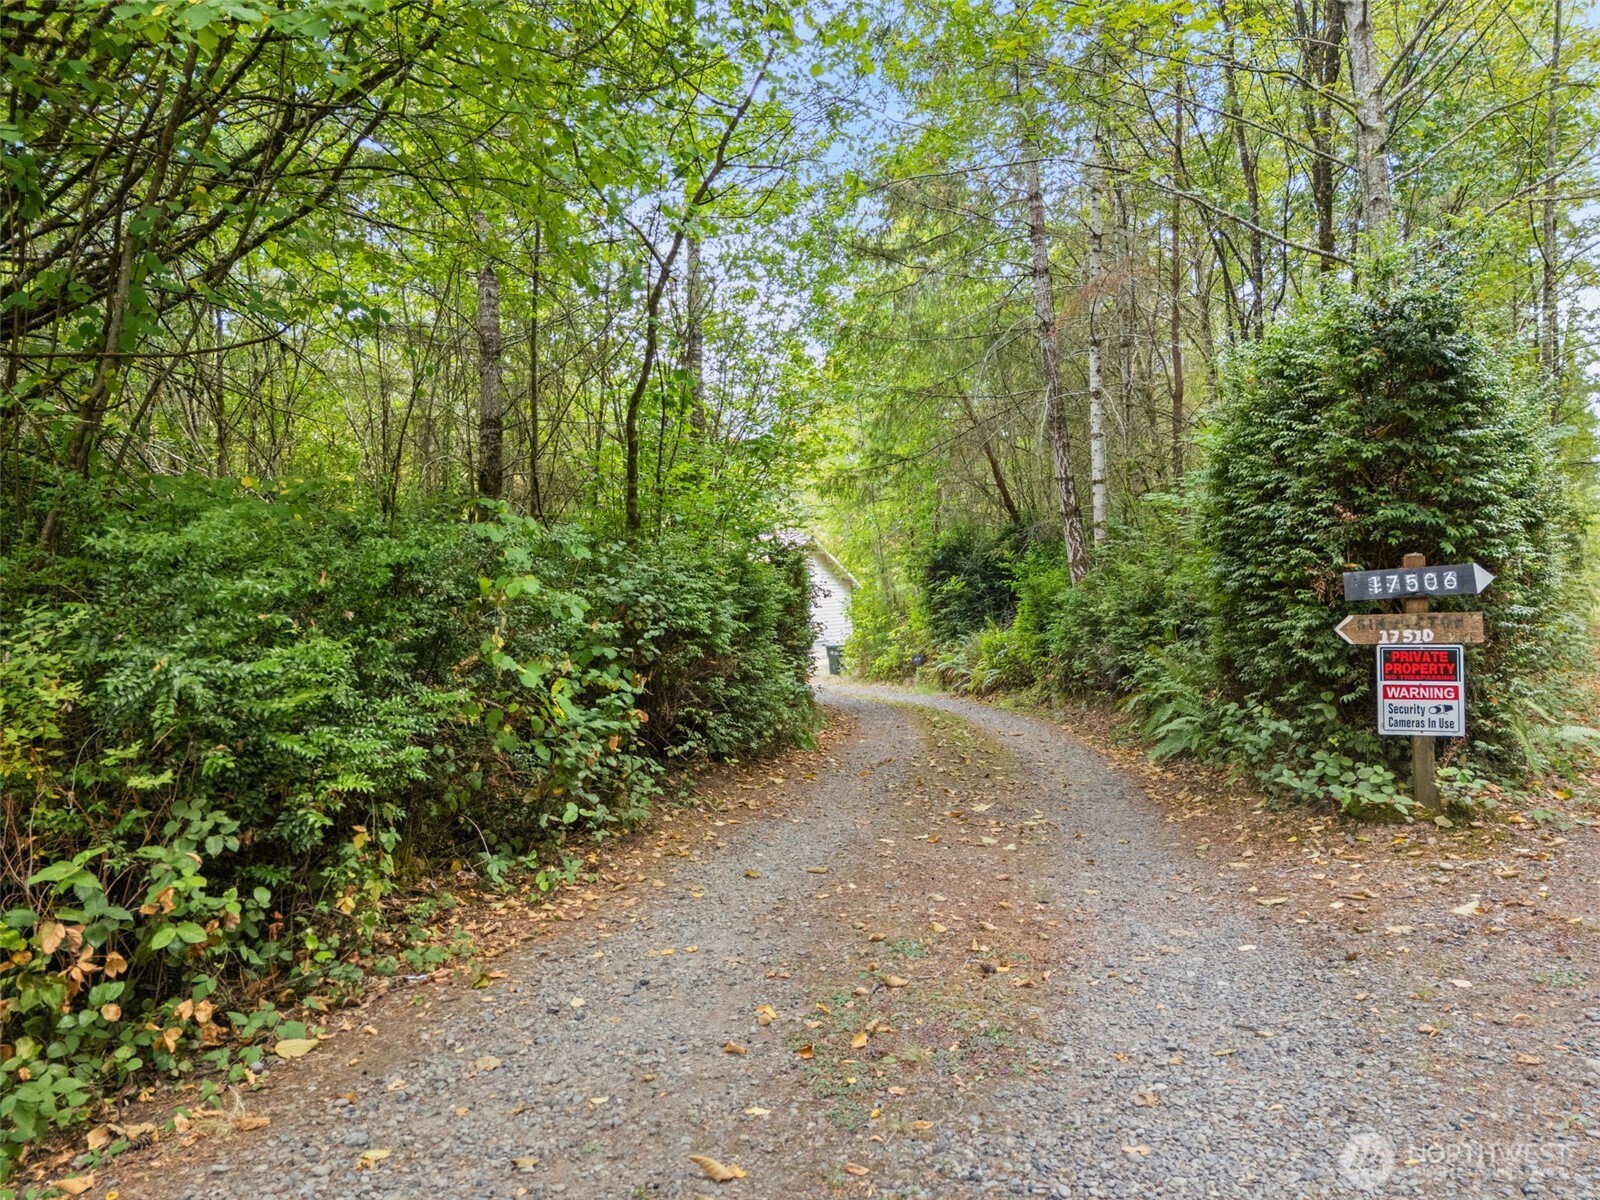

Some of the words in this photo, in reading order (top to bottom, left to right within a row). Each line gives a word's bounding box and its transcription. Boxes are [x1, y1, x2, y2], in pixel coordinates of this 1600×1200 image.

[1368, 571, 1457, 593] 17506
[1378, 629, 1434, 643] 17510
[1391, 651, 1449, 662] PRIVATE
[1384, 663, 1456, 674] PROPERTY
[1386, 687, 1455, 698] WARNING
[1388, 703, 1426, 717] Security
[1388, 716, 1426, 728] Cameras
[1428, 718, 1437, 728] In
[1439, 718, 1455, 729] Use
